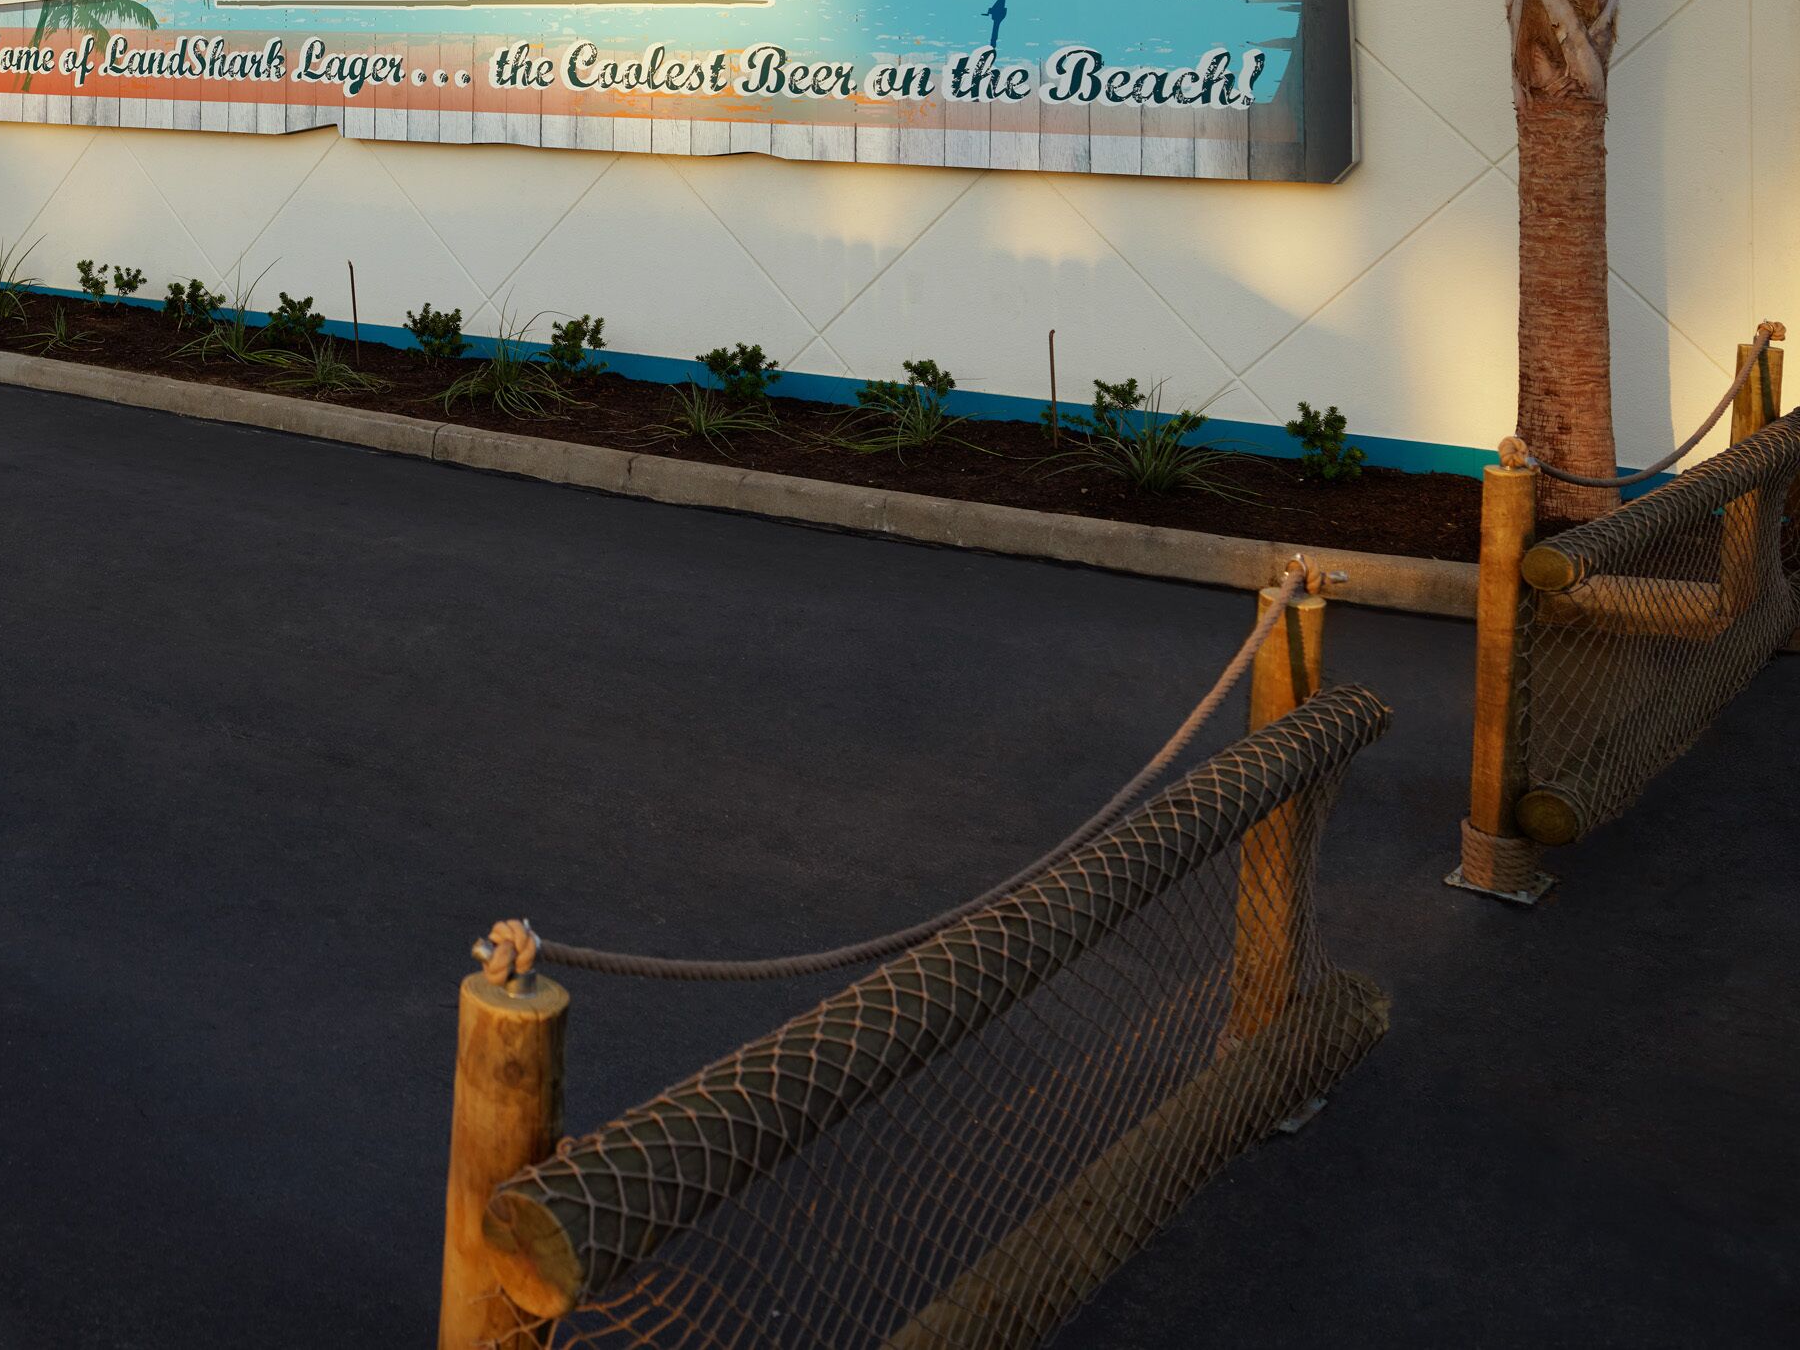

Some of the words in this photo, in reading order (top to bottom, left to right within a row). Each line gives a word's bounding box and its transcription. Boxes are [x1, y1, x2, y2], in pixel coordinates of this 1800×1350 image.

[65, 36, 95, 85] of
[105, 36, 287, 81] LandShark
[496, 41, 555, 89] the
[566, 43, 728, 93] Coolest
[747, 46, 856, 95] Beer
[875, 61, 936, 101] on
[950, 47, 1030, 103] the
[1049, 47, 1264, 108] Beach!
